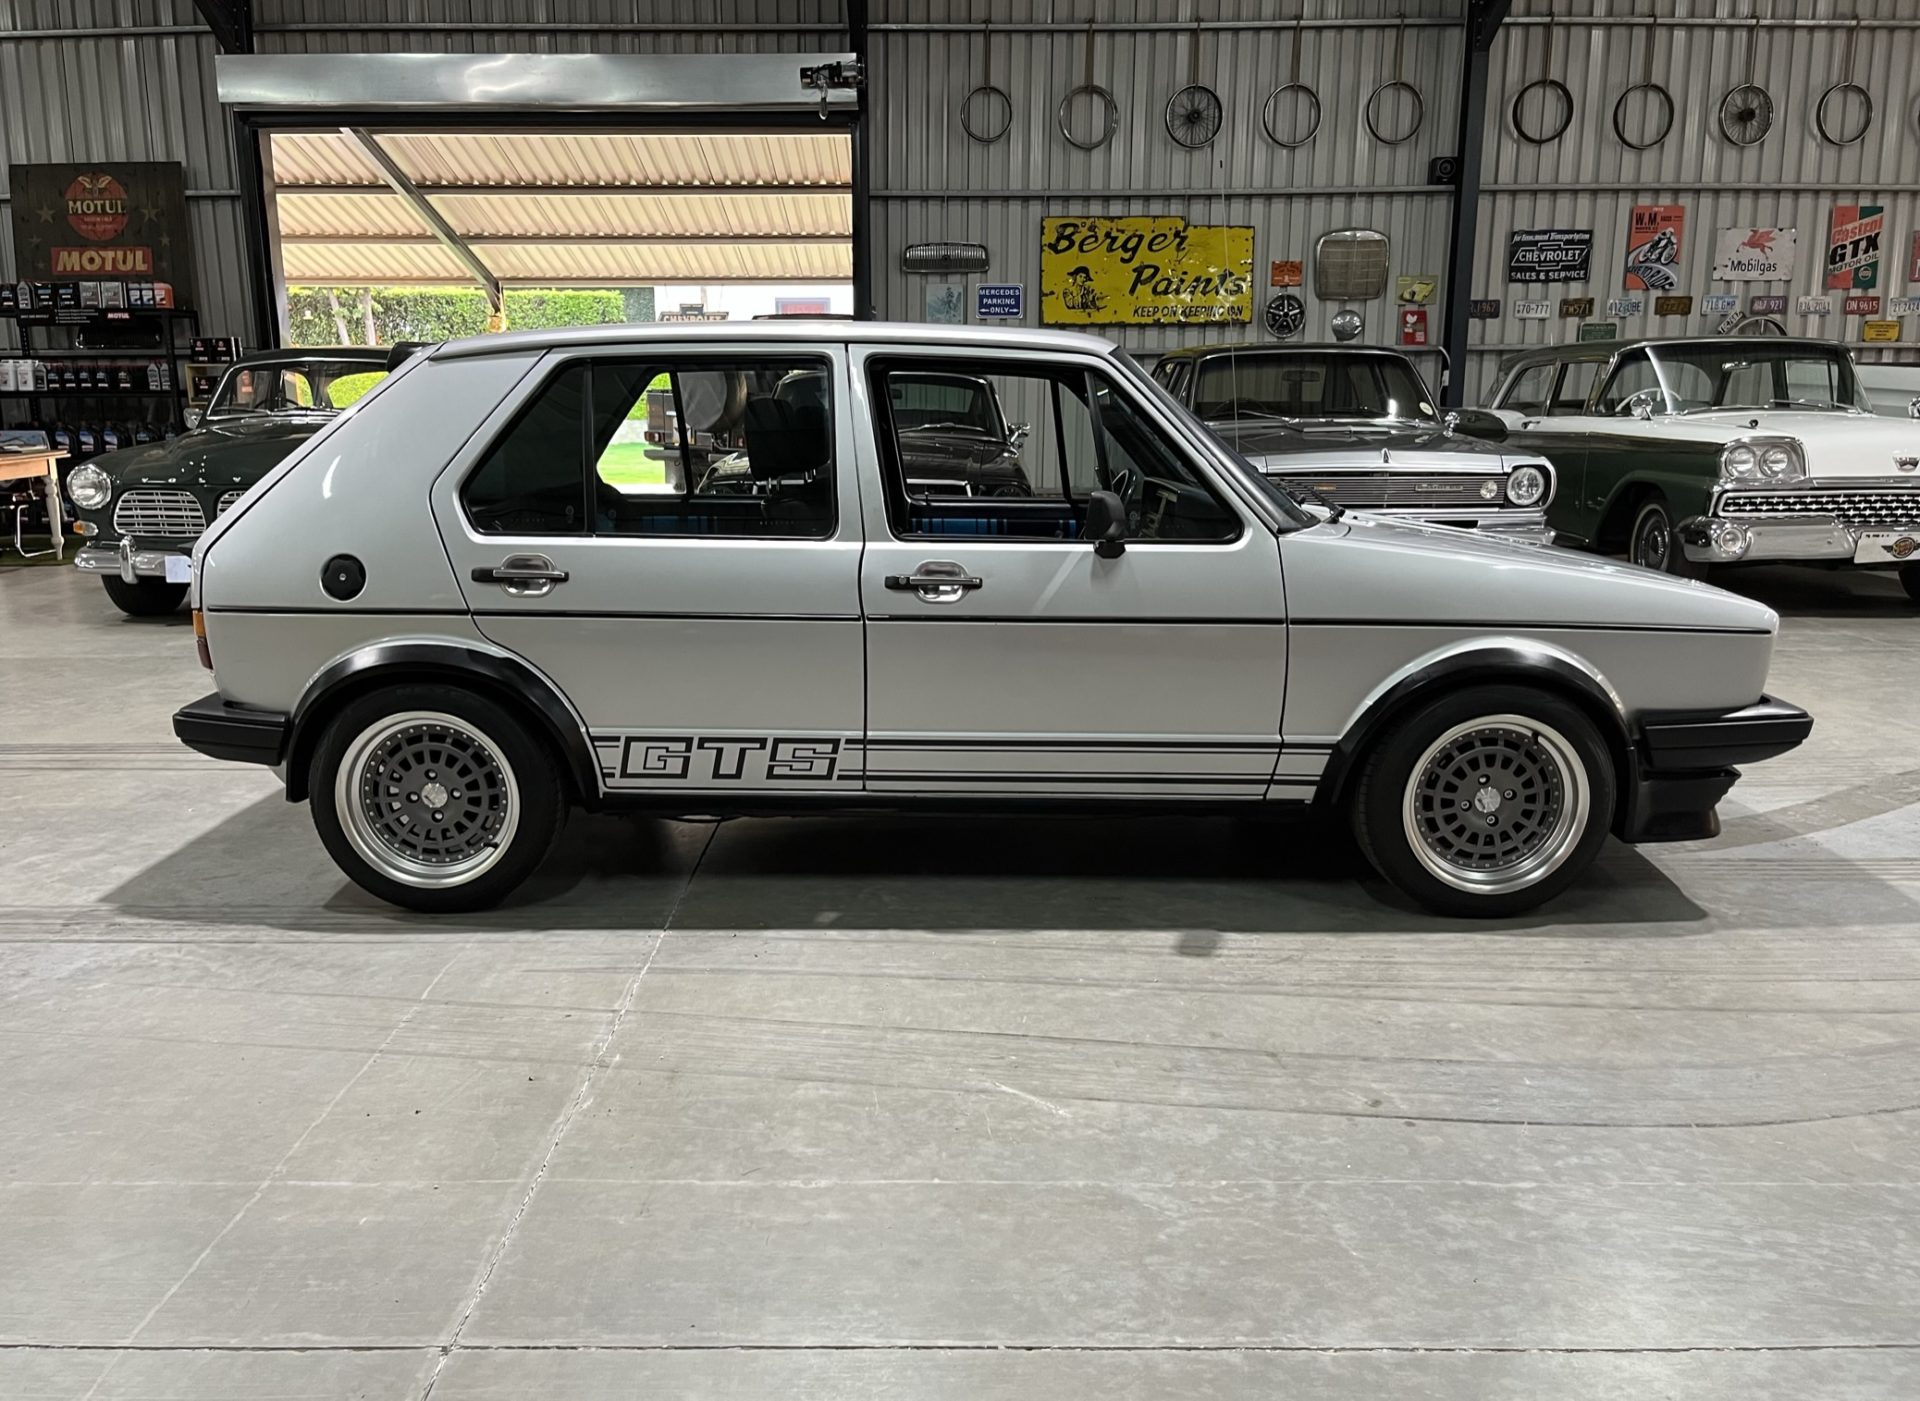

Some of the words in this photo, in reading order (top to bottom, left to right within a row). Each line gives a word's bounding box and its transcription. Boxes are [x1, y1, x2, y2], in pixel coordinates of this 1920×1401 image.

[68, 200, 126, 214] MOTUL
[1832, 215, 1883, 245] Castrol
[1047, 222, 1188, 264] Berger
[1829, 231, 1880, 265] GTX
[57, 250, 148, 271] MOTUL
[1519, 250, 1580, 261] CHEVROLET
[1829, 258, 1862, 272] MOTOR
[1864, 253, 1879, 261] OIL
[1511, 271, 1537, 280] SALES
[1549, 270, 1585, 279] SERVICE
[1730, 258, 1777, 276] Mobilgas
[1128, 264, 1245, 297] Paints
[1133, 305, 1160, 318] KEEP
[1161, 305, 1177, 317] ON
[1859, 300, 1878, 310] 9615
[619, 735, 841, 781] GTS
